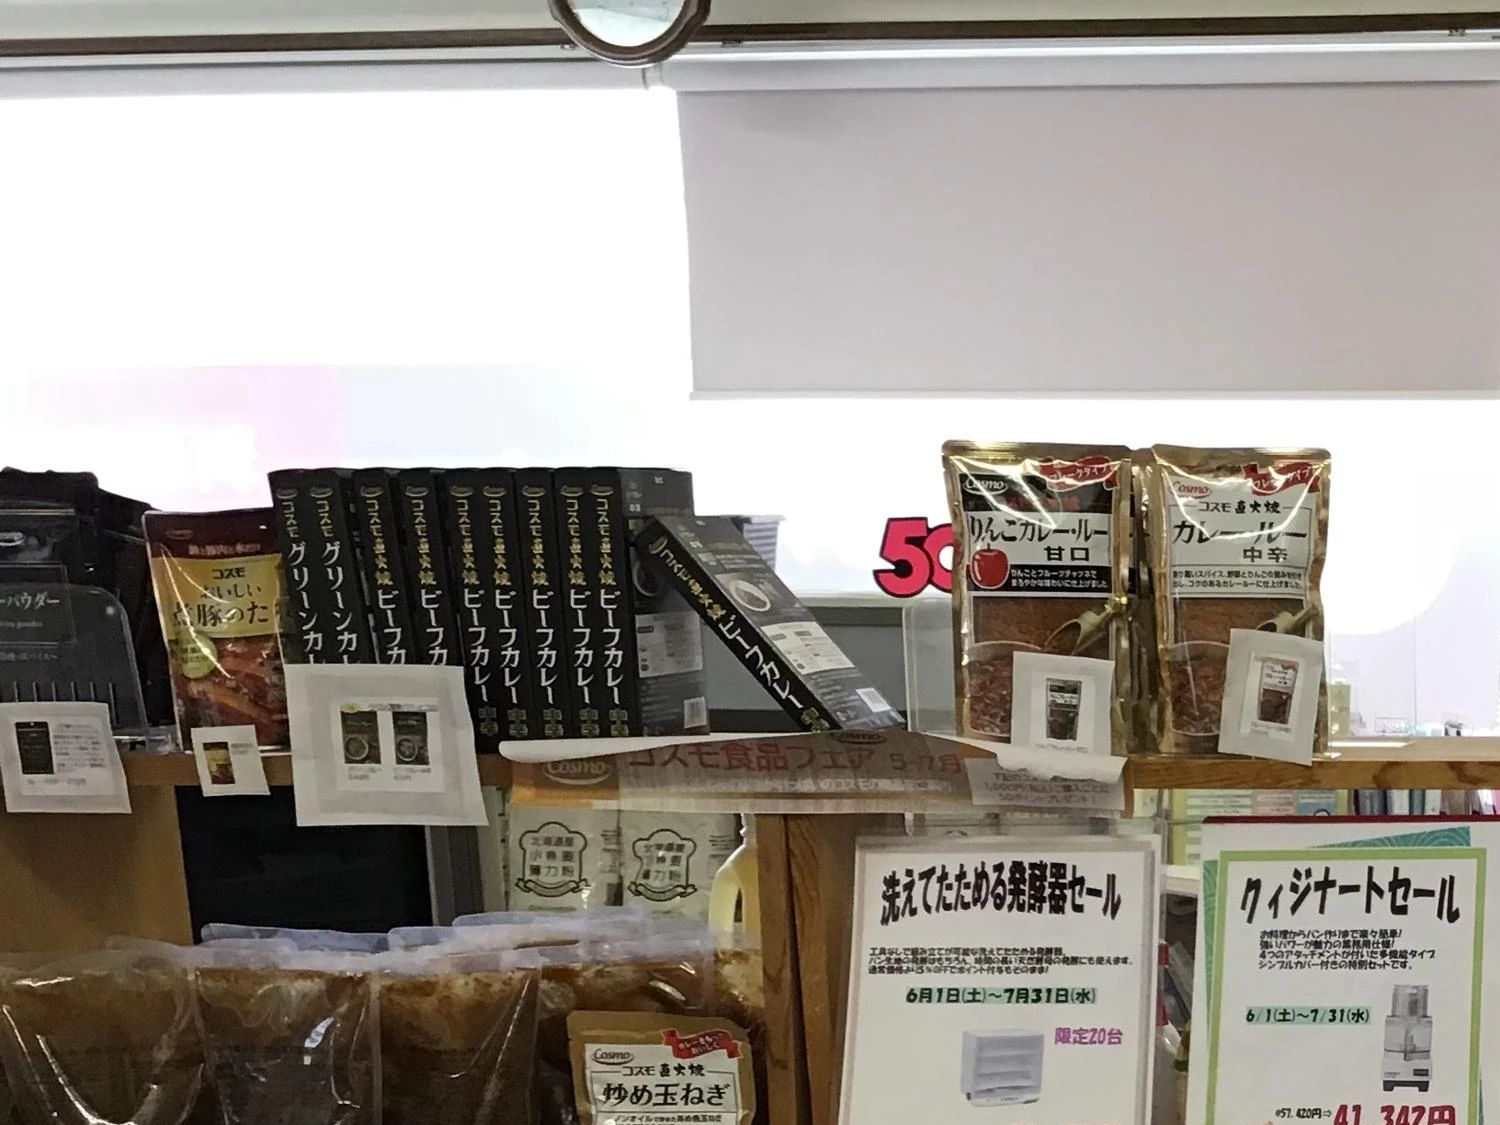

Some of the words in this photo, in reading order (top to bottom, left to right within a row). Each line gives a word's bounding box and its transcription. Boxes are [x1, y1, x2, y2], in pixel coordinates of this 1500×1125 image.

[1044, 546, 1090, 562] 甘口
[1243, 547, 1288, 562] 中辛
[212, 567, 246, 580] コスモ
[880, 860, 1122, 926] 洗えてたためる発酵器セール
[1240, 866, 1460, 924] クィジナートセール
[1054, 1027, 1124, 1046] 限定20台
[593, 1048, 631, 1061] Cosmo
[602, 1083, 731, 1107] 炒め玉ねぎ
